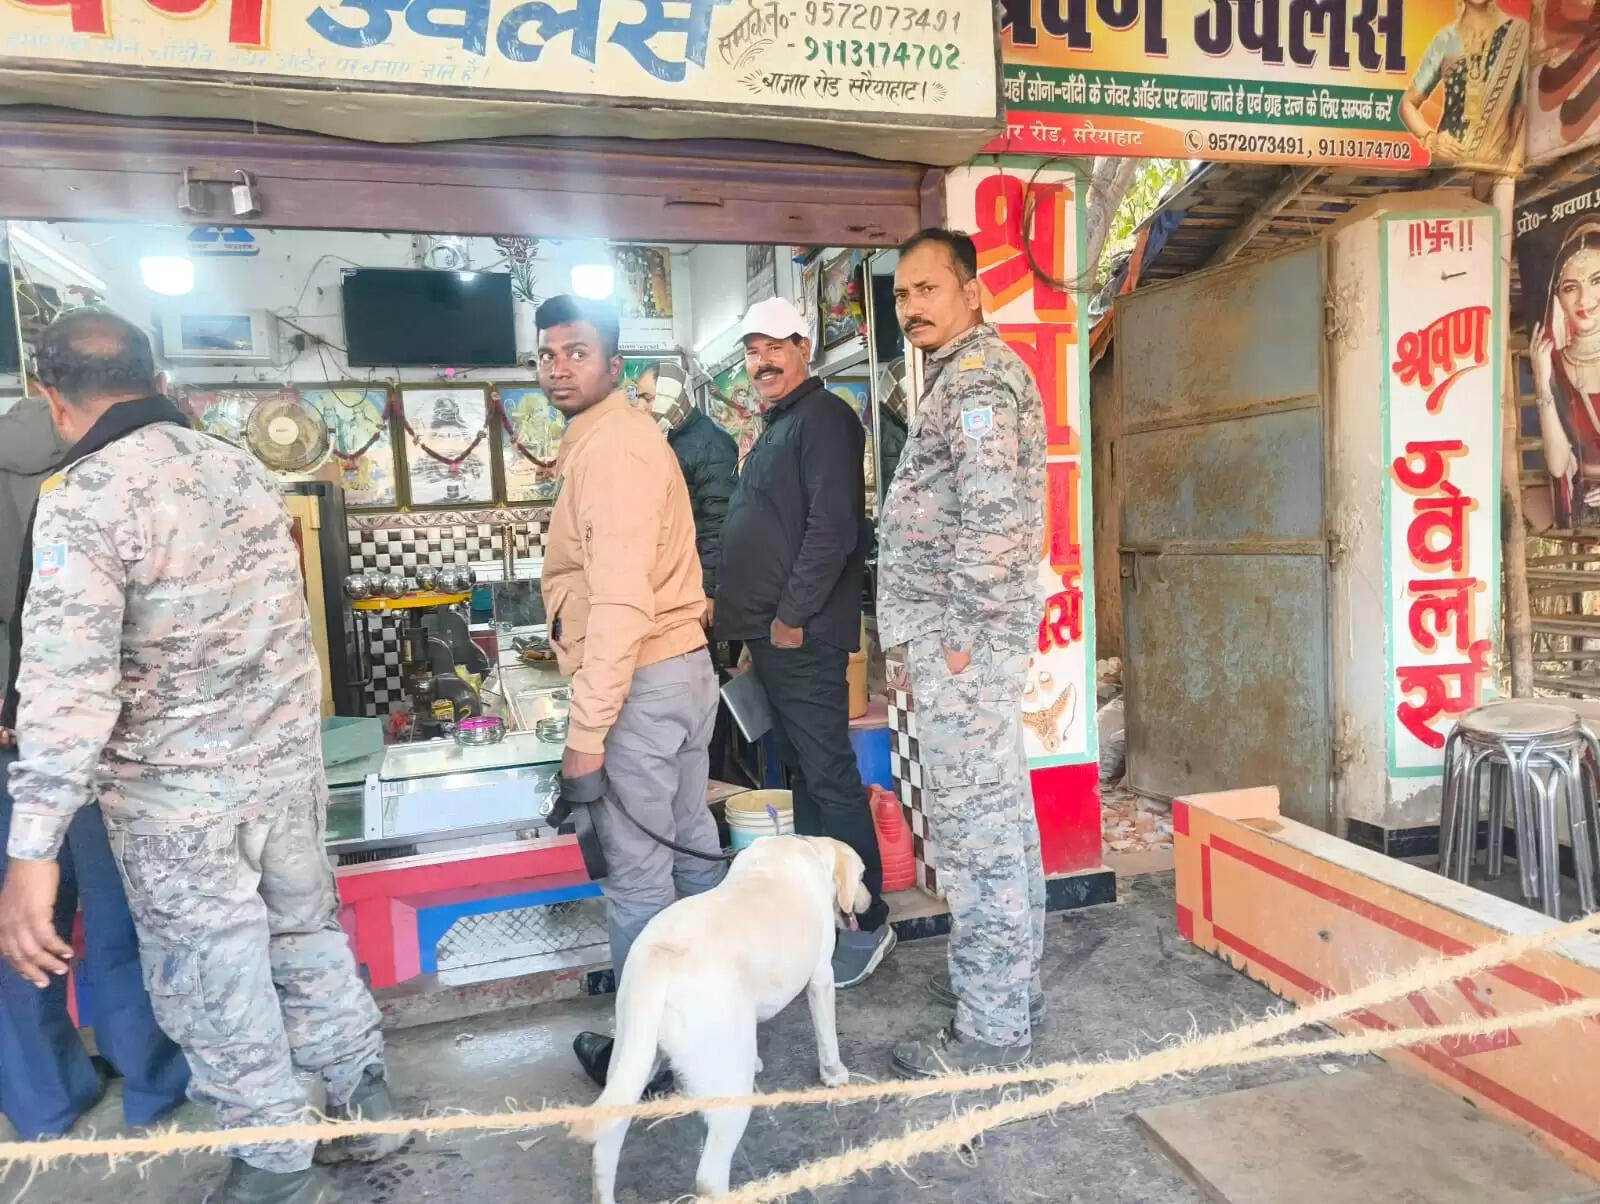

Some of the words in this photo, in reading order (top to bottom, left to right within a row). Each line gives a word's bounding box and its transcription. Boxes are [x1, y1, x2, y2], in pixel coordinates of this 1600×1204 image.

[804, 0, 961, 34] 9572073491
[804, 36, 960, 71] 9113174702
[762, 69, 805, 100] बाजार
[813, 69, 842, 98] रोड
[1003, 69, 1026, 102] यहाँ
[1089, 75, 1101, 105] के
[1103, 76, 1131, 108] जेवर
[1132, 77, 1162, 110] ऑर्डर
[1163, 88, 1179, 110] पर
[1180, 89, 1208, 112] बनाए
[1210, 84, 1234, 113] जाते
[1247, 86, 1263, 114] एवं
[1264, 94, 1282, 118] ग्रह
[1284, 95, 1304, 117] रत्न
[1305, 89, 1317, 117] के
[1320, 88, 1339, 119] लिए
[1341, 92, 1374, 120] सम्पर्क
[1375, 94, 1394, 122] करें
[1073, 120, 1144, 147] सरैयाहाट
[1208, 132, 1312, 158] 9572073491,
[1318, 138, 1411, 160] 9113174702
[1550, 191, 1593, 223] श्रवण
[1391, 305, 1493, 391] श्रवण
